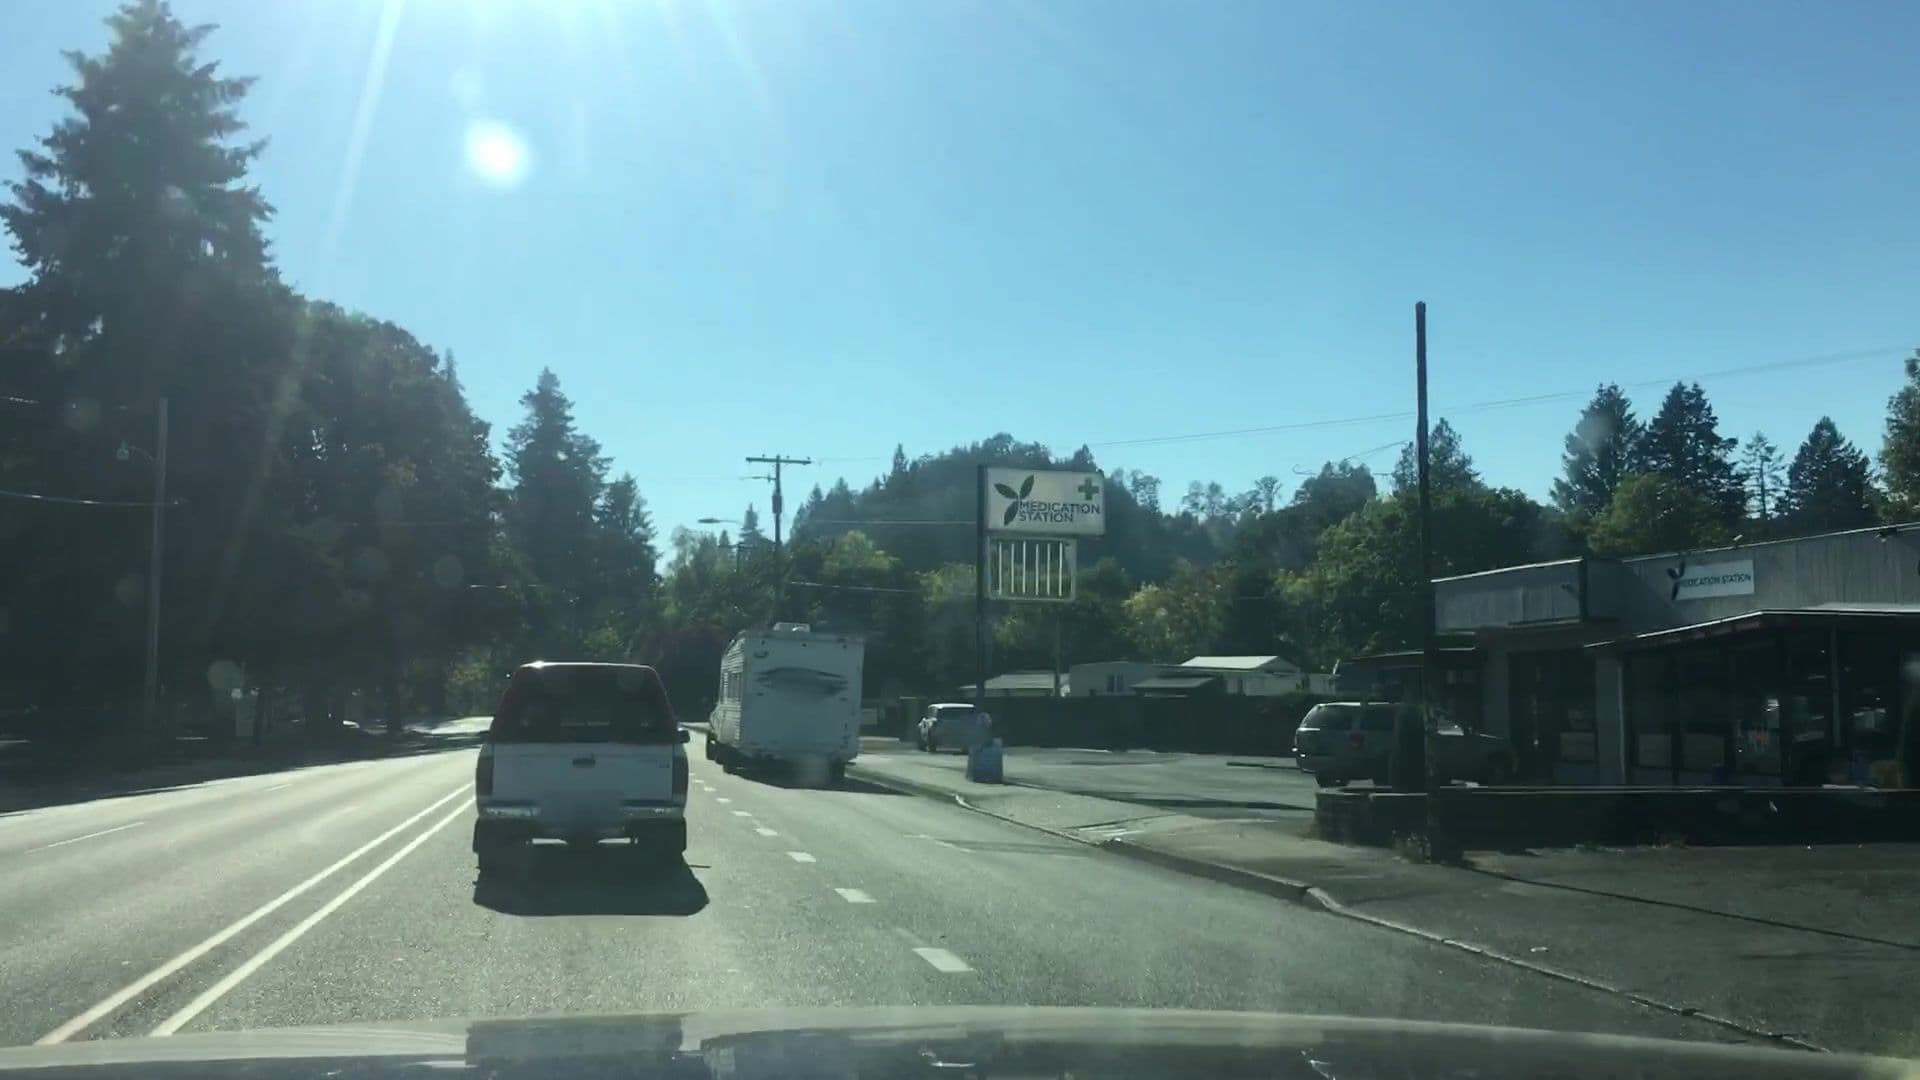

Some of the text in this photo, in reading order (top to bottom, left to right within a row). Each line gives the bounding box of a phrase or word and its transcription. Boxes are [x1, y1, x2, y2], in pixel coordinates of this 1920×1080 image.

[1020, 501, 1100, 514] MEDICATION
[1019, 511, 1073, 523] STATION
[1721, 573, 1751, 584] STATION
